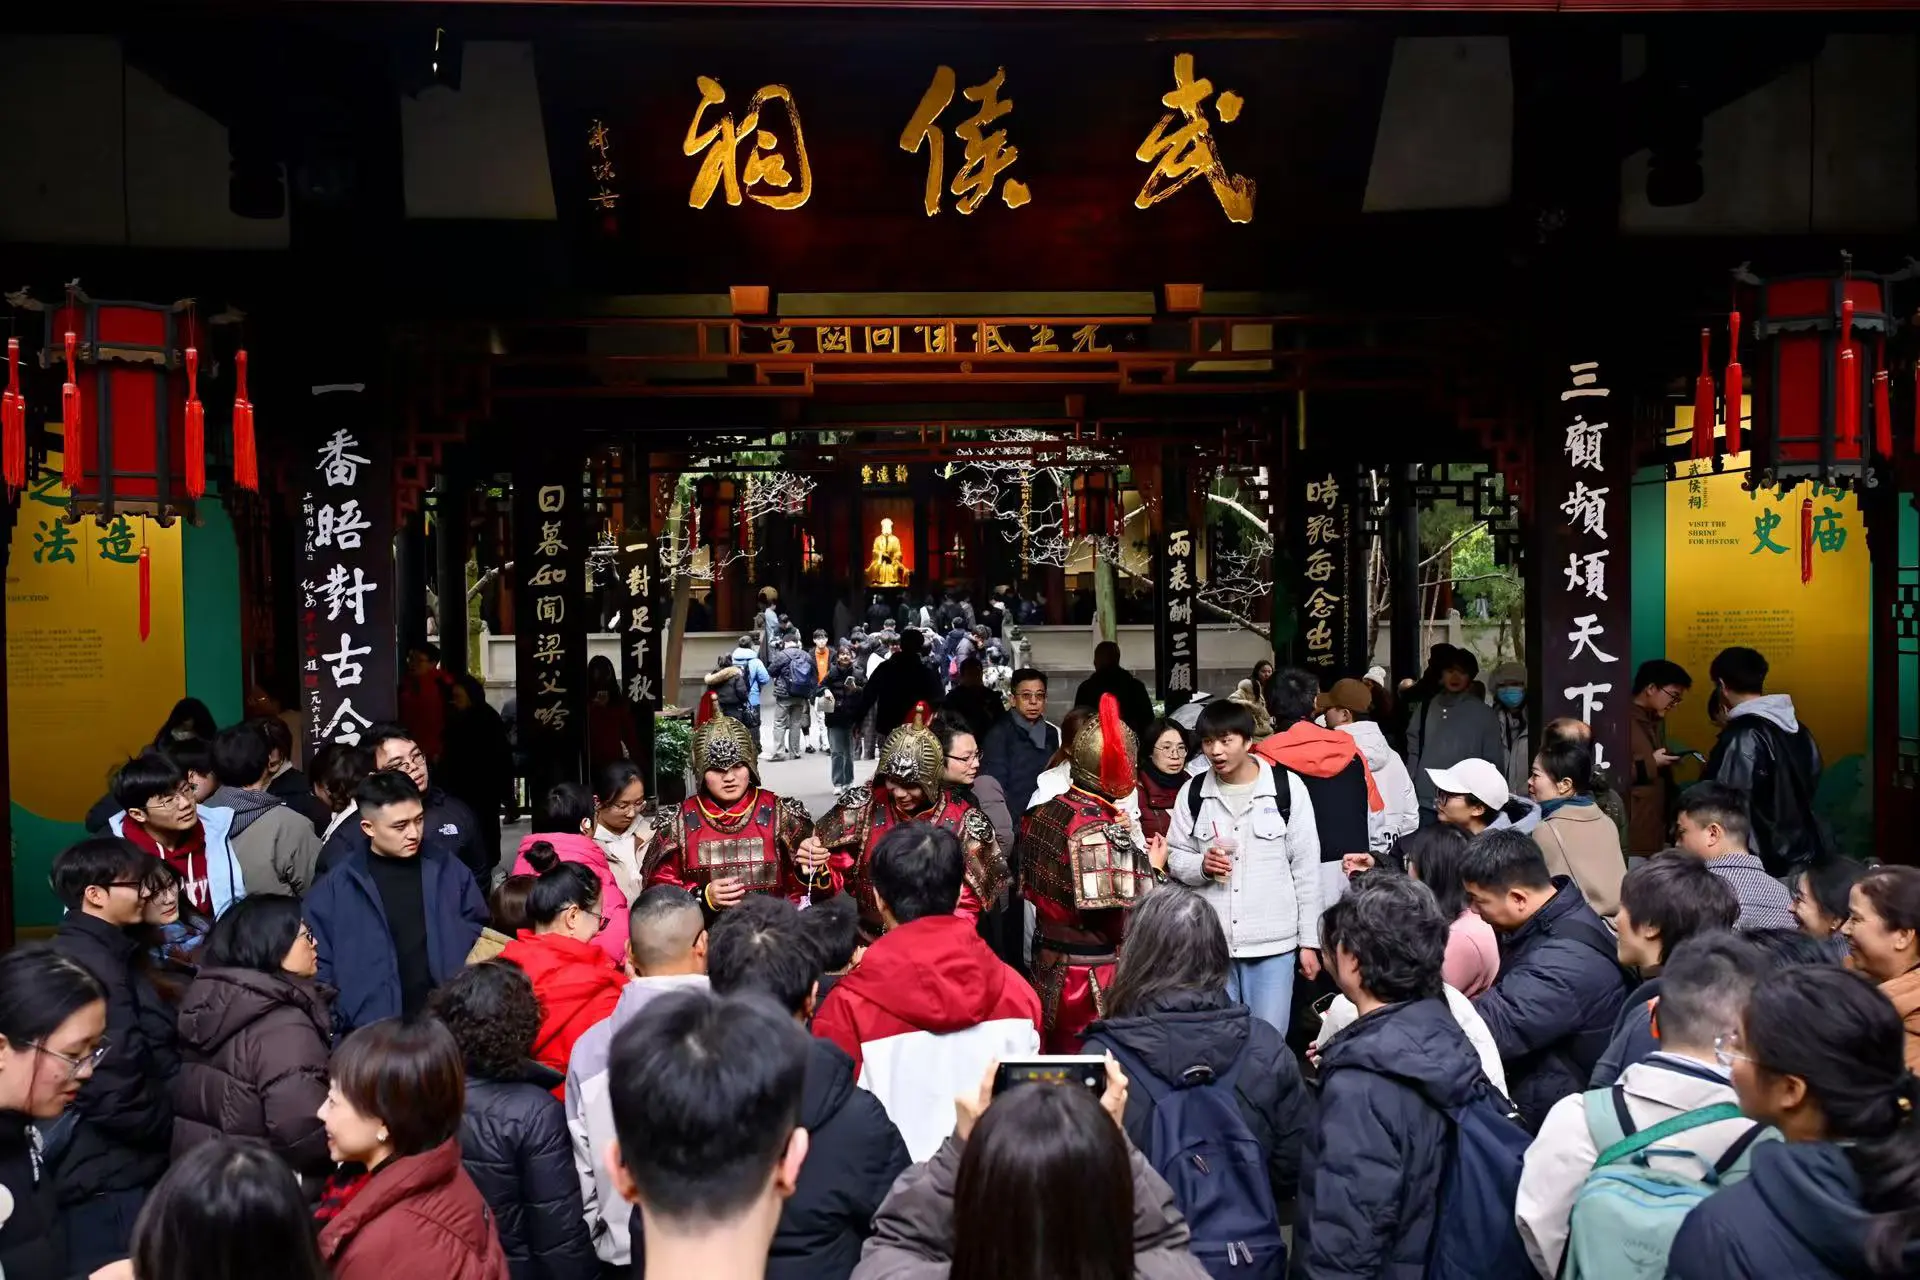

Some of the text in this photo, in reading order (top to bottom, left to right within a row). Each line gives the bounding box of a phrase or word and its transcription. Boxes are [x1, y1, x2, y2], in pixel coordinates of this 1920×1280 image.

[683, 53, 1257, 224] 武侯祠
[1687, 463, 1702, 510] 武侯祠
[97, 516, 141, 564] 造
[1688, 520, 1727, 528] VISIT THE
[1688, 529, 1716, 537] SHRINE
[1560, 361, 1620, 769] 三顧頻煩天下
[624, 542, 657, 703] 一對足千秋
